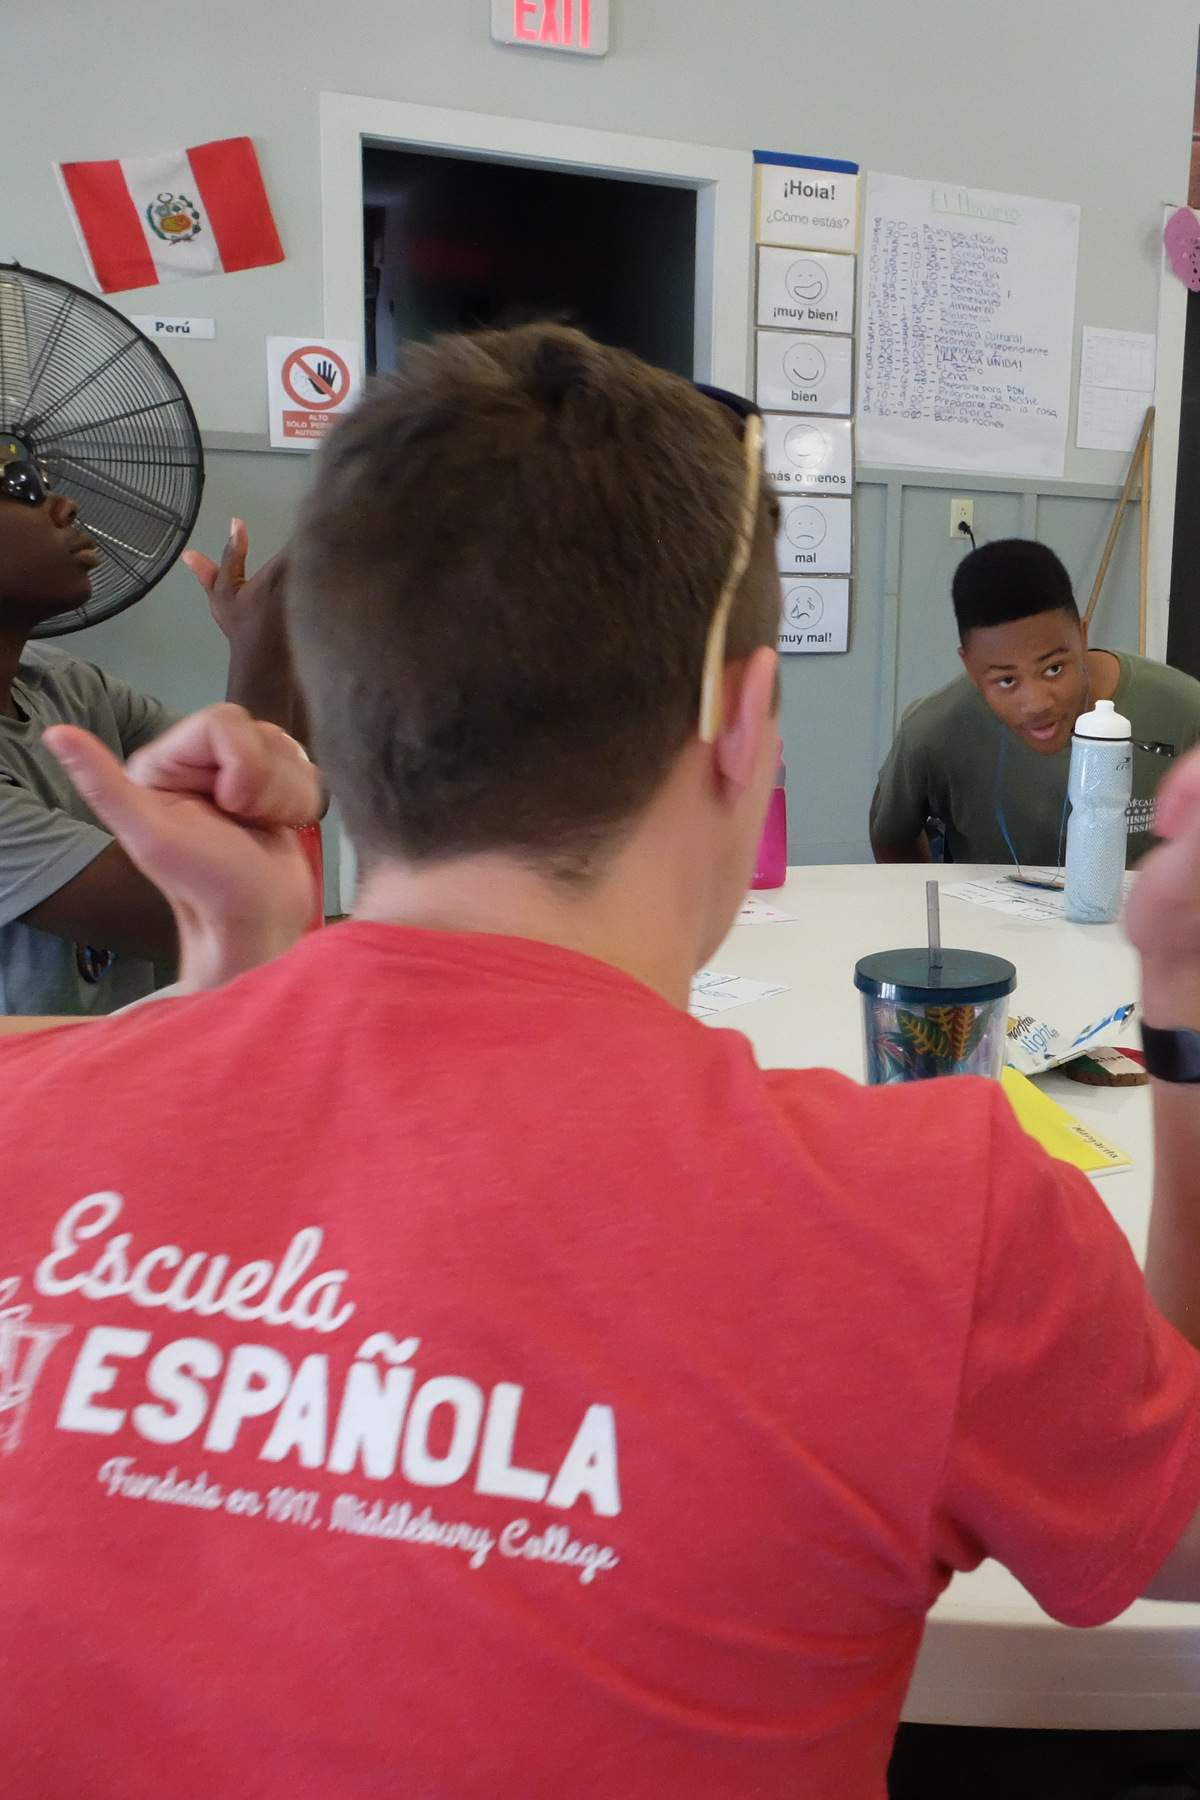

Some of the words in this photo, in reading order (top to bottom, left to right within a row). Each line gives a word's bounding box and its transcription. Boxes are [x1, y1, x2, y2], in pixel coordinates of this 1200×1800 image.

[784, 179, 835, 200] ¡Hola!
[766, 209, 809, 225] ¿Cómo
[812, 215, 850, 229] estás?
[773, 307, 804, 320] ¡muy
[807, 308, 838, 322] bien!
[155, 321, 191, 334] Perú
[791, 391, 818, 402] bien
[806, 474, 846, 484] menos
[795, 553, 817, 563] mal
[806, 633, 832, 643] mal!
[33, 1190, 357, 1333] Escuela
[56, 1326, 622, 1517] ESPAÑOLA
[224, 1487, 264, 1517] en
[327, 1493, 496, 1570] Middlebury
[498, 1517, 620, 1585] College
